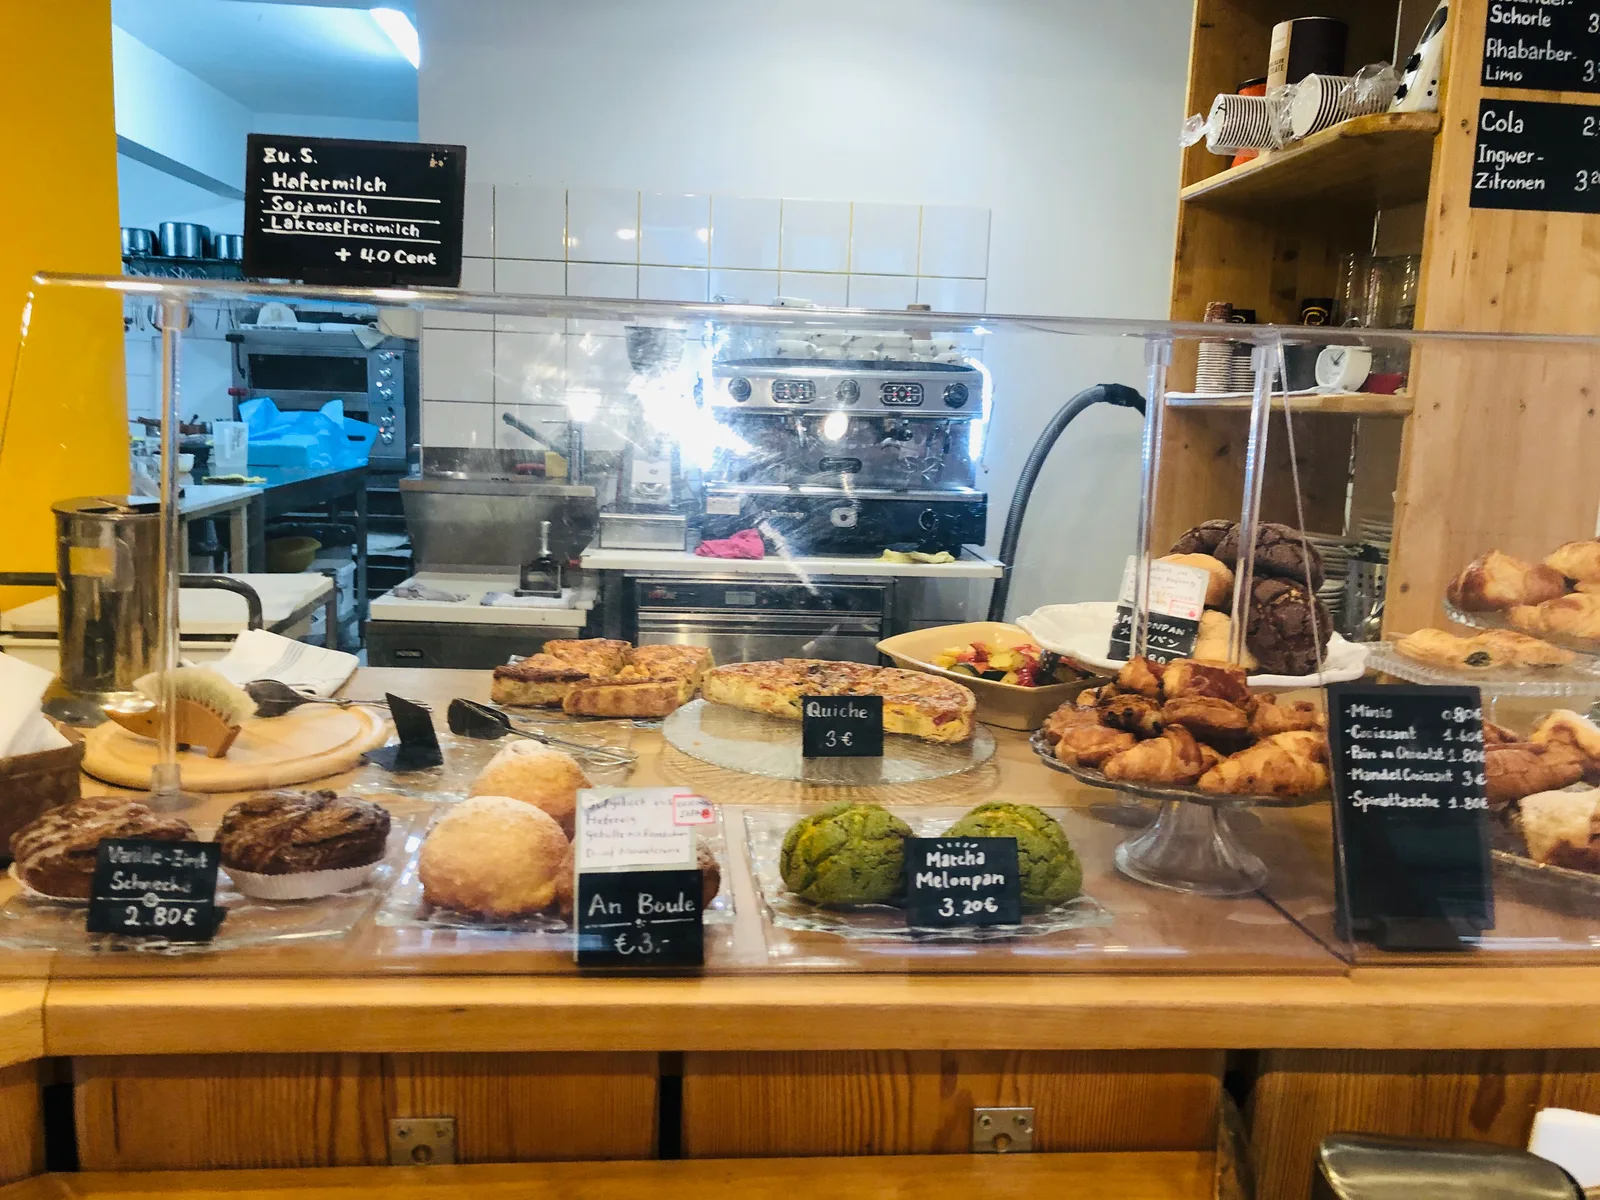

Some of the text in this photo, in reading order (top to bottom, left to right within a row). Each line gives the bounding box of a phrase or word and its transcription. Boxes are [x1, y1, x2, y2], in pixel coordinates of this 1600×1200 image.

[1490, 4, 1552, 28] Schorle
[1485, 37, 1578, 63] Rhabarber-
[1485, 63, 1523, 82] Limo
[1481, 110, 1525, 134] Cola
[1477, 143, 1545, 171] Ingwer-
[271, 171, 388, 193] Hafermilch
[1474, 171, 1546, 191] Zitronen
[271, 195, 368, 219] Sojamilch
[360, 248, 391, 263] 40
[394, 248, 437, 266] Cent
[806, 701, 868, 719] Quiche
[915, 870, 1005, 891] Melonpan
[587, 891, 696, 917] An Boule
